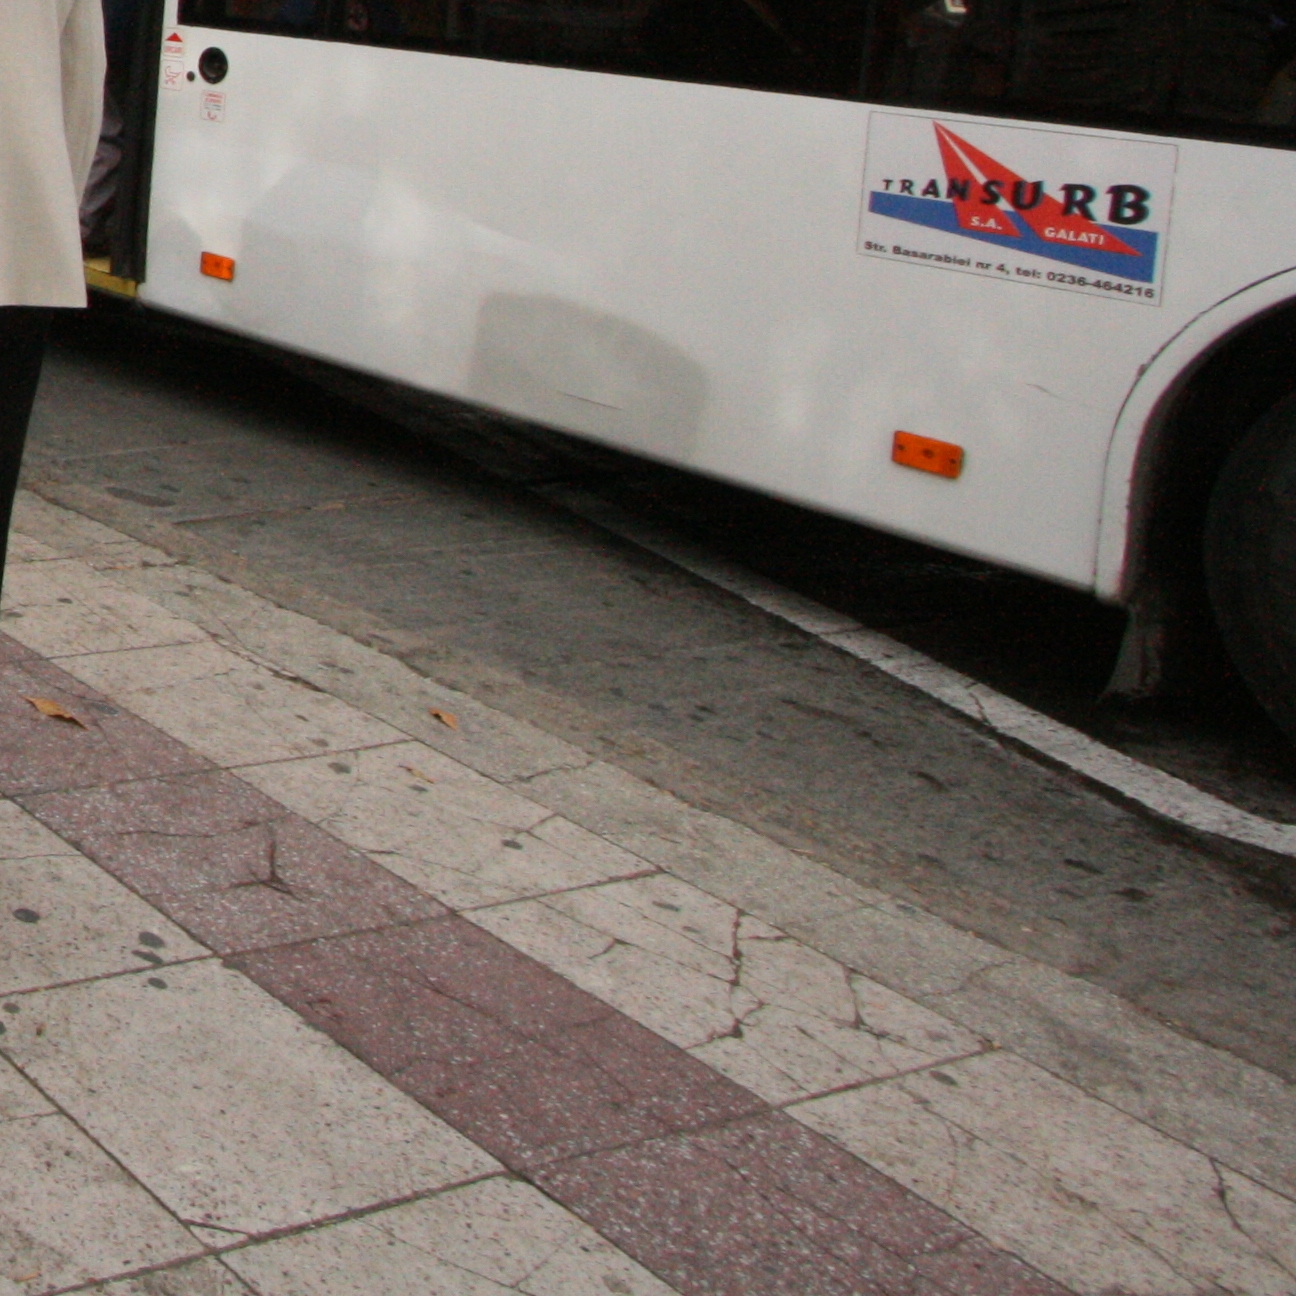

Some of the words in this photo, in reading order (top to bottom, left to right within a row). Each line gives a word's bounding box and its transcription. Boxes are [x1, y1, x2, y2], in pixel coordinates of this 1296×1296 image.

[881, 177, 1154, 226] TRANSURB
[970, 214, 1004, 231] S.A.
[864, 240, 887, 253] Str.
[892, 245, 972, 267] Basarabiei
[975, 261, 991, 270] nr
